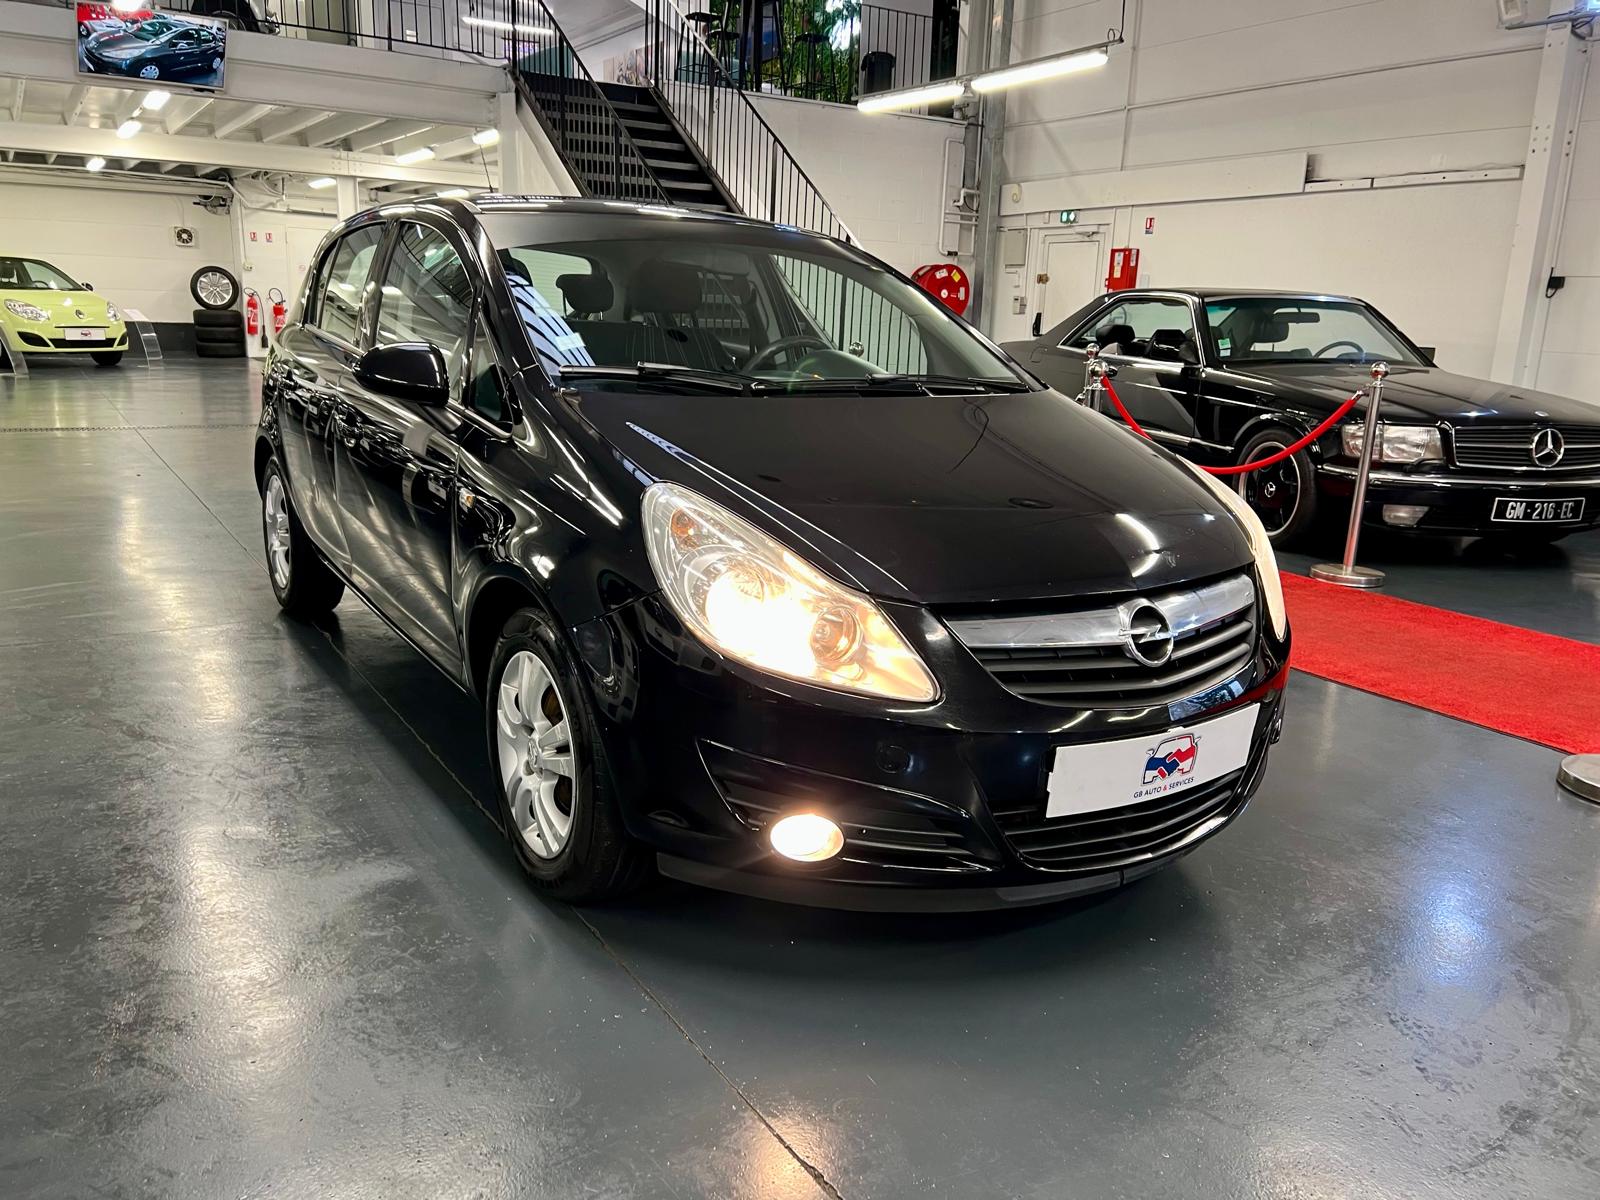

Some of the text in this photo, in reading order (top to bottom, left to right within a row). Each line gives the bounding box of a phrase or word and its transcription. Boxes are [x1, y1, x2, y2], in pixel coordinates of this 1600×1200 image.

[1133, 776, 1194, 798] GB AUTO & SERVICES
